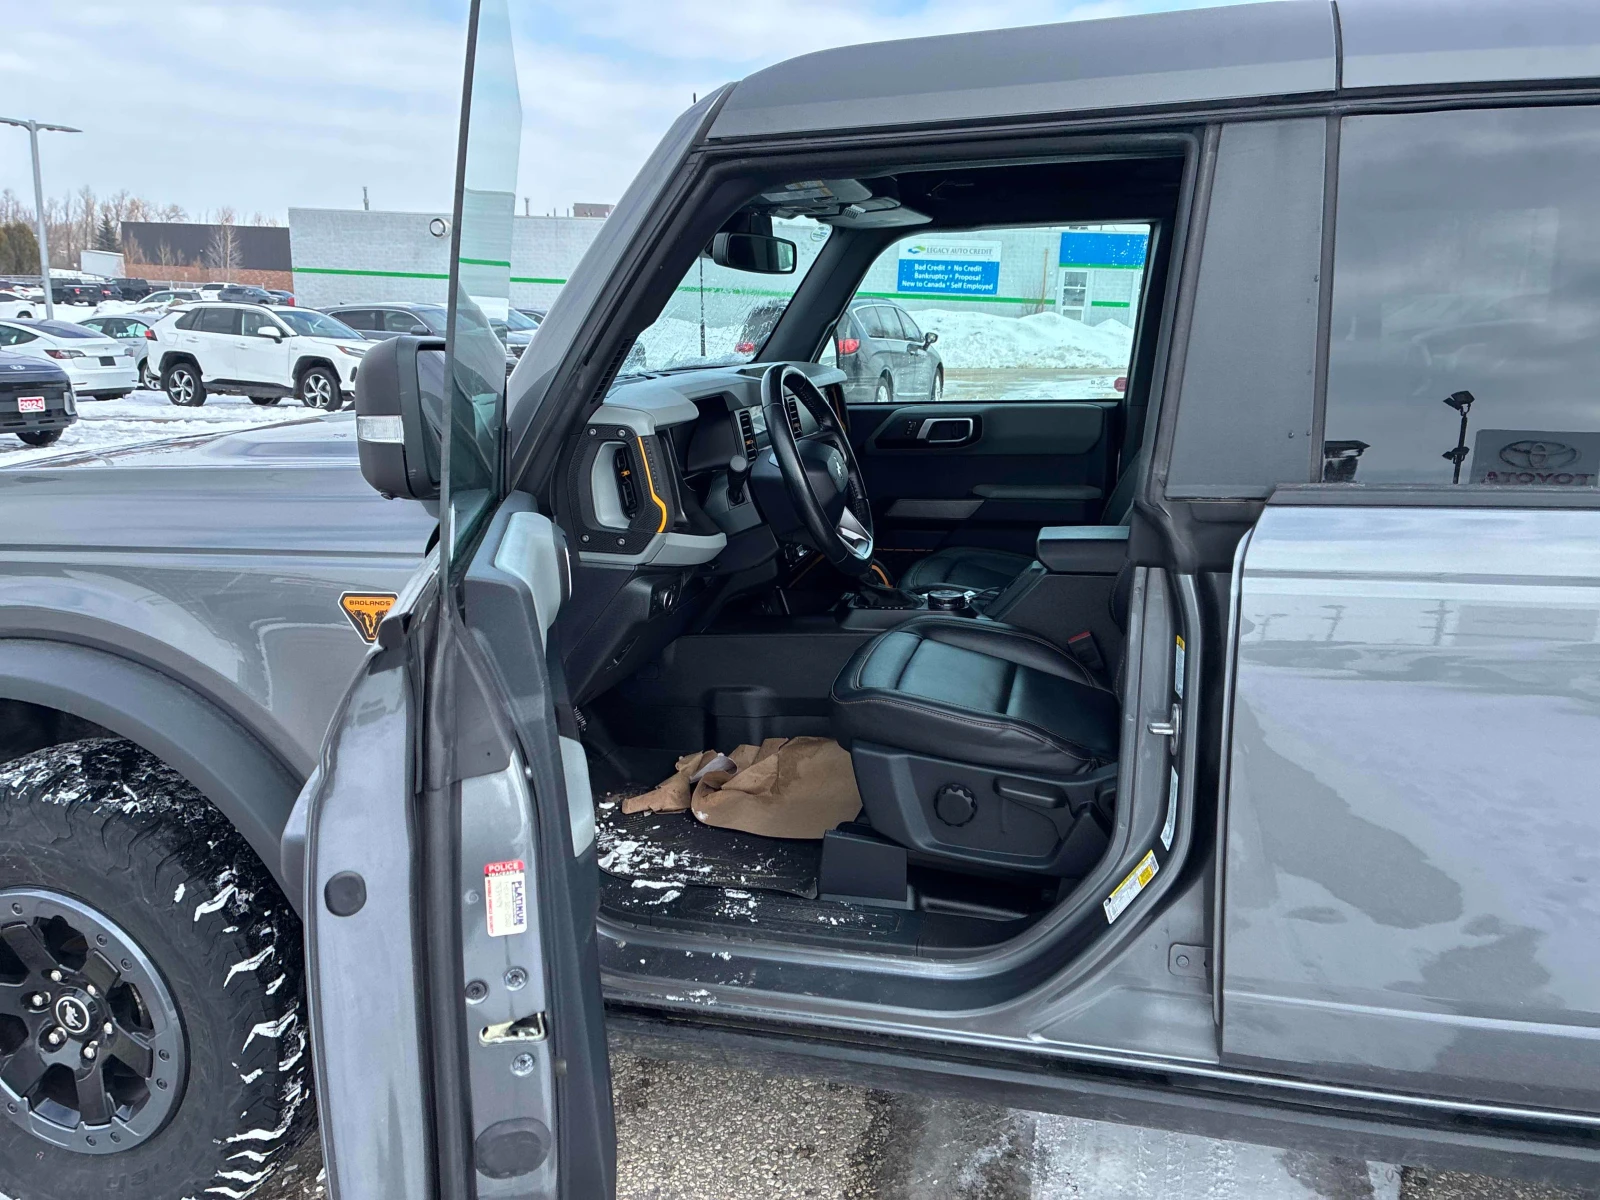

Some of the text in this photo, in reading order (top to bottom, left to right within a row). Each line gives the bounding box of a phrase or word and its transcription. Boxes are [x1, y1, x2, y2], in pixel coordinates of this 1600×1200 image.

[914, 263, 926, 271] Bad
[914, 272, 981, 281] Bankruptcy Proposal
[951, 281, 962, 289] Self
[963, 283, 993, 291] Employed
[21, 400, 42, 409] 2024
[488, 862, 519, 872] POLICE
[515, 881, 524, 925] PLATINUM
